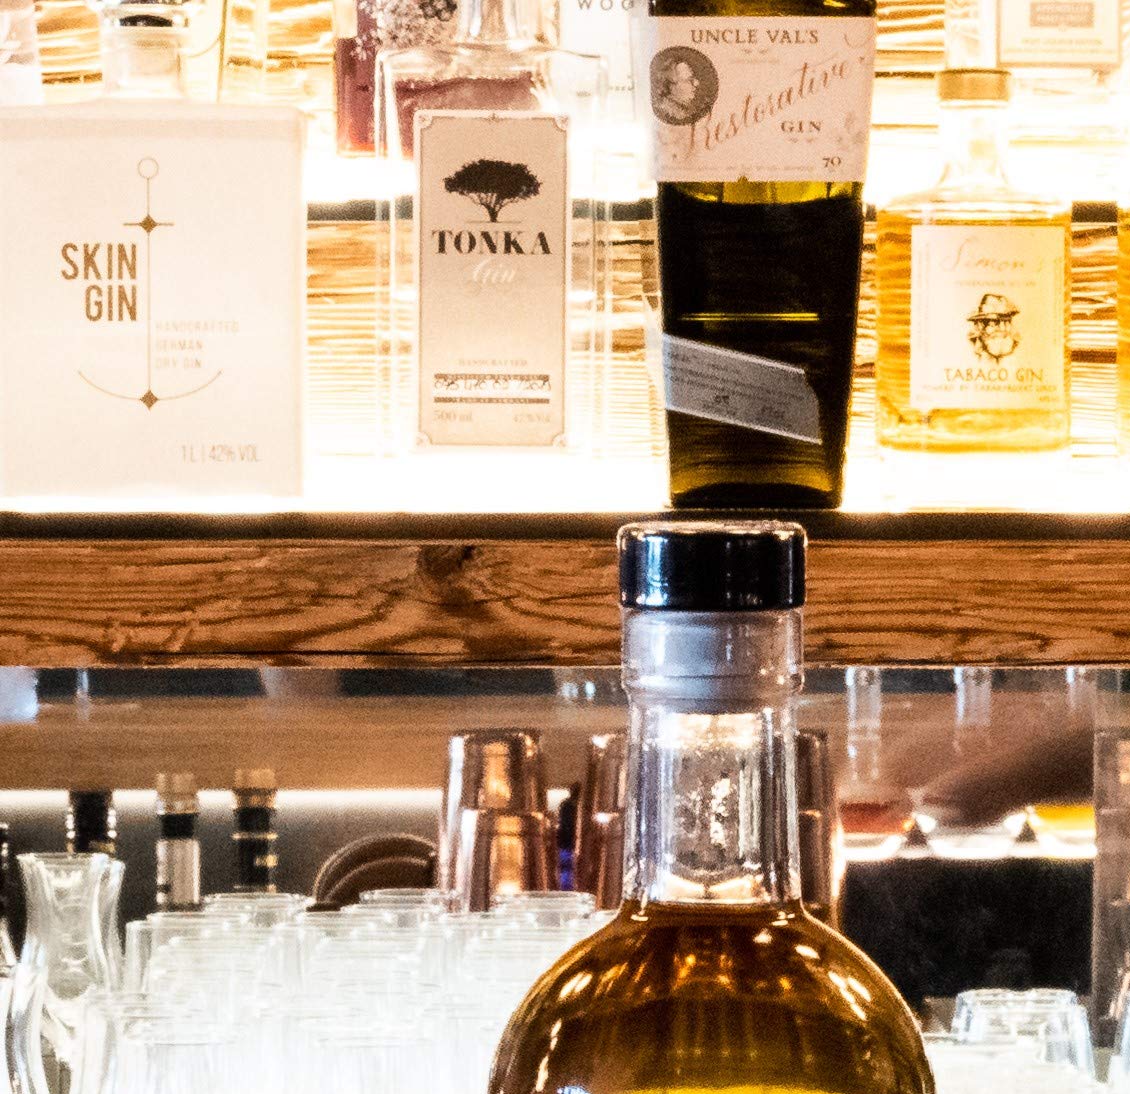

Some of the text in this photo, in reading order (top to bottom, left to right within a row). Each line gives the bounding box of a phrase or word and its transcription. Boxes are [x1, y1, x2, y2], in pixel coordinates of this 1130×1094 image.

[691, 28, 819, 44] UNCLE VAL'S
[780, 119, 823, 134] GIN
[822, 156, 842, 168] 70
[431, 229, 553, 255] TONKA
[62, 243, 138, 280] SKIN
[85, 285, 138, 322] GIN
[944, 367, 1044, 383] TABACO GIN
